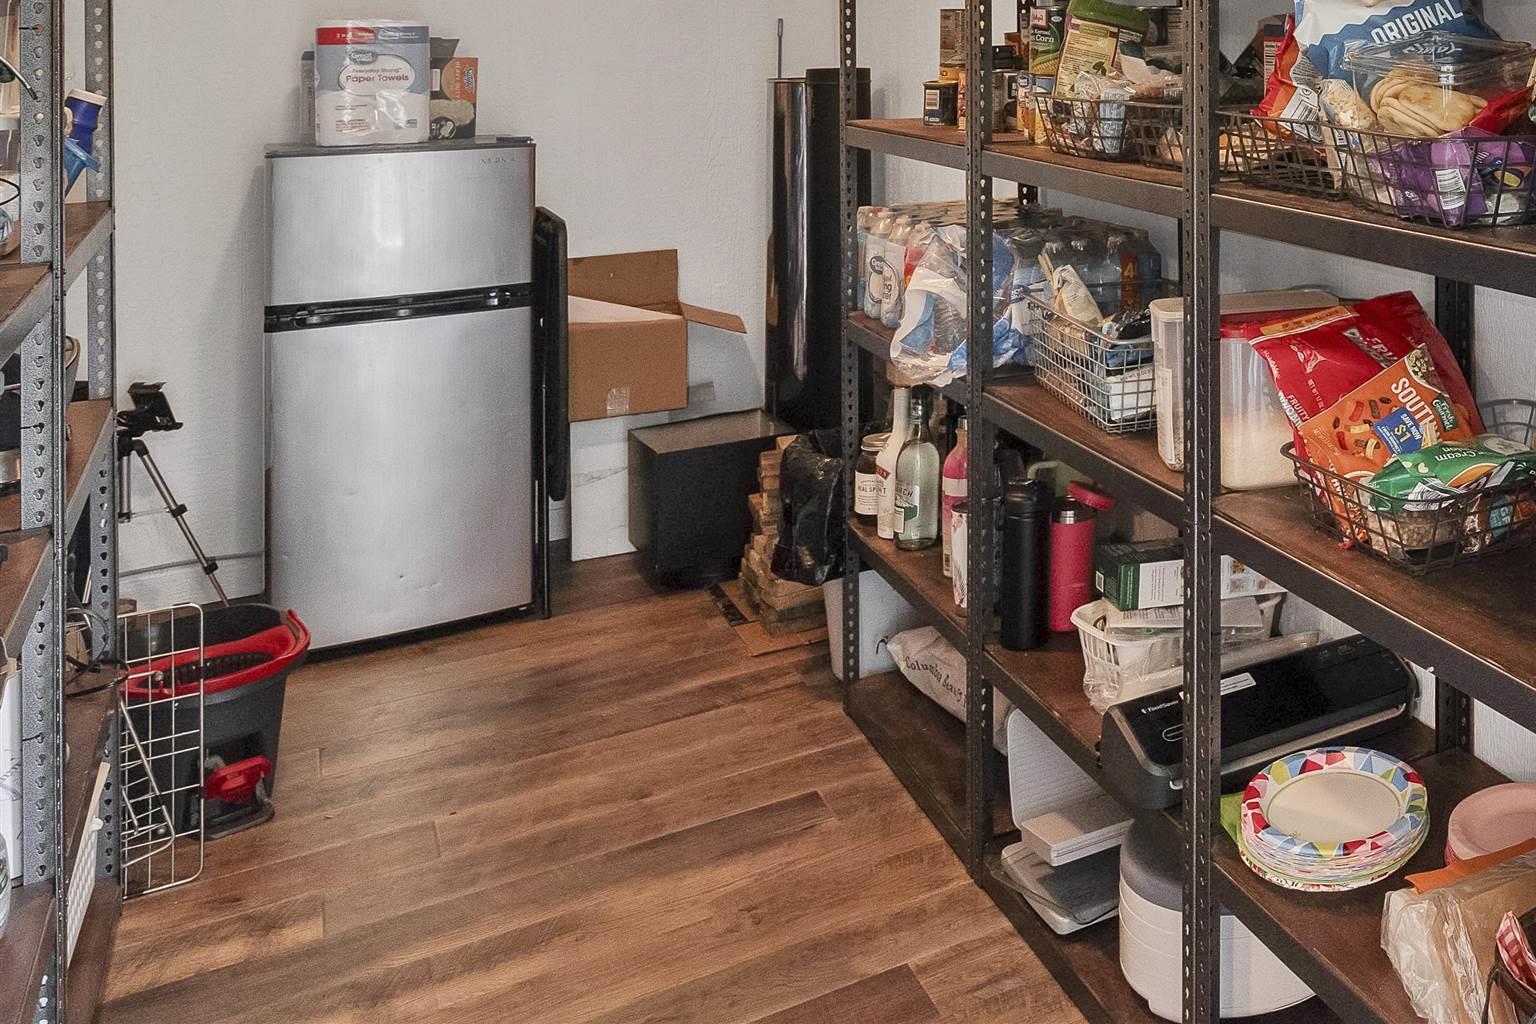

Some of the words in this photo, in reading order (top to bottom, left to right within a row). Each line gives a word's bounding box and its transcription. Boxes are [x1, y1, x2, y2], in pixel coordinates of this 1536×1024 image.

[1370, 0, 1464, 44] ORIGINAL
[1036, 34, 1055, 43] Corn
[346, 75, 374, 83] Paper
[378, 73, 409, 82] Towels
[1287, 394, 1310, 421] FRUITY
[1394, 424, 1412, 443] $1
[1400, 413, 1414, 428] SAVE
[1409, 425, 1423, 441] NOW
[1435, 450, 1476, 462] Cream
